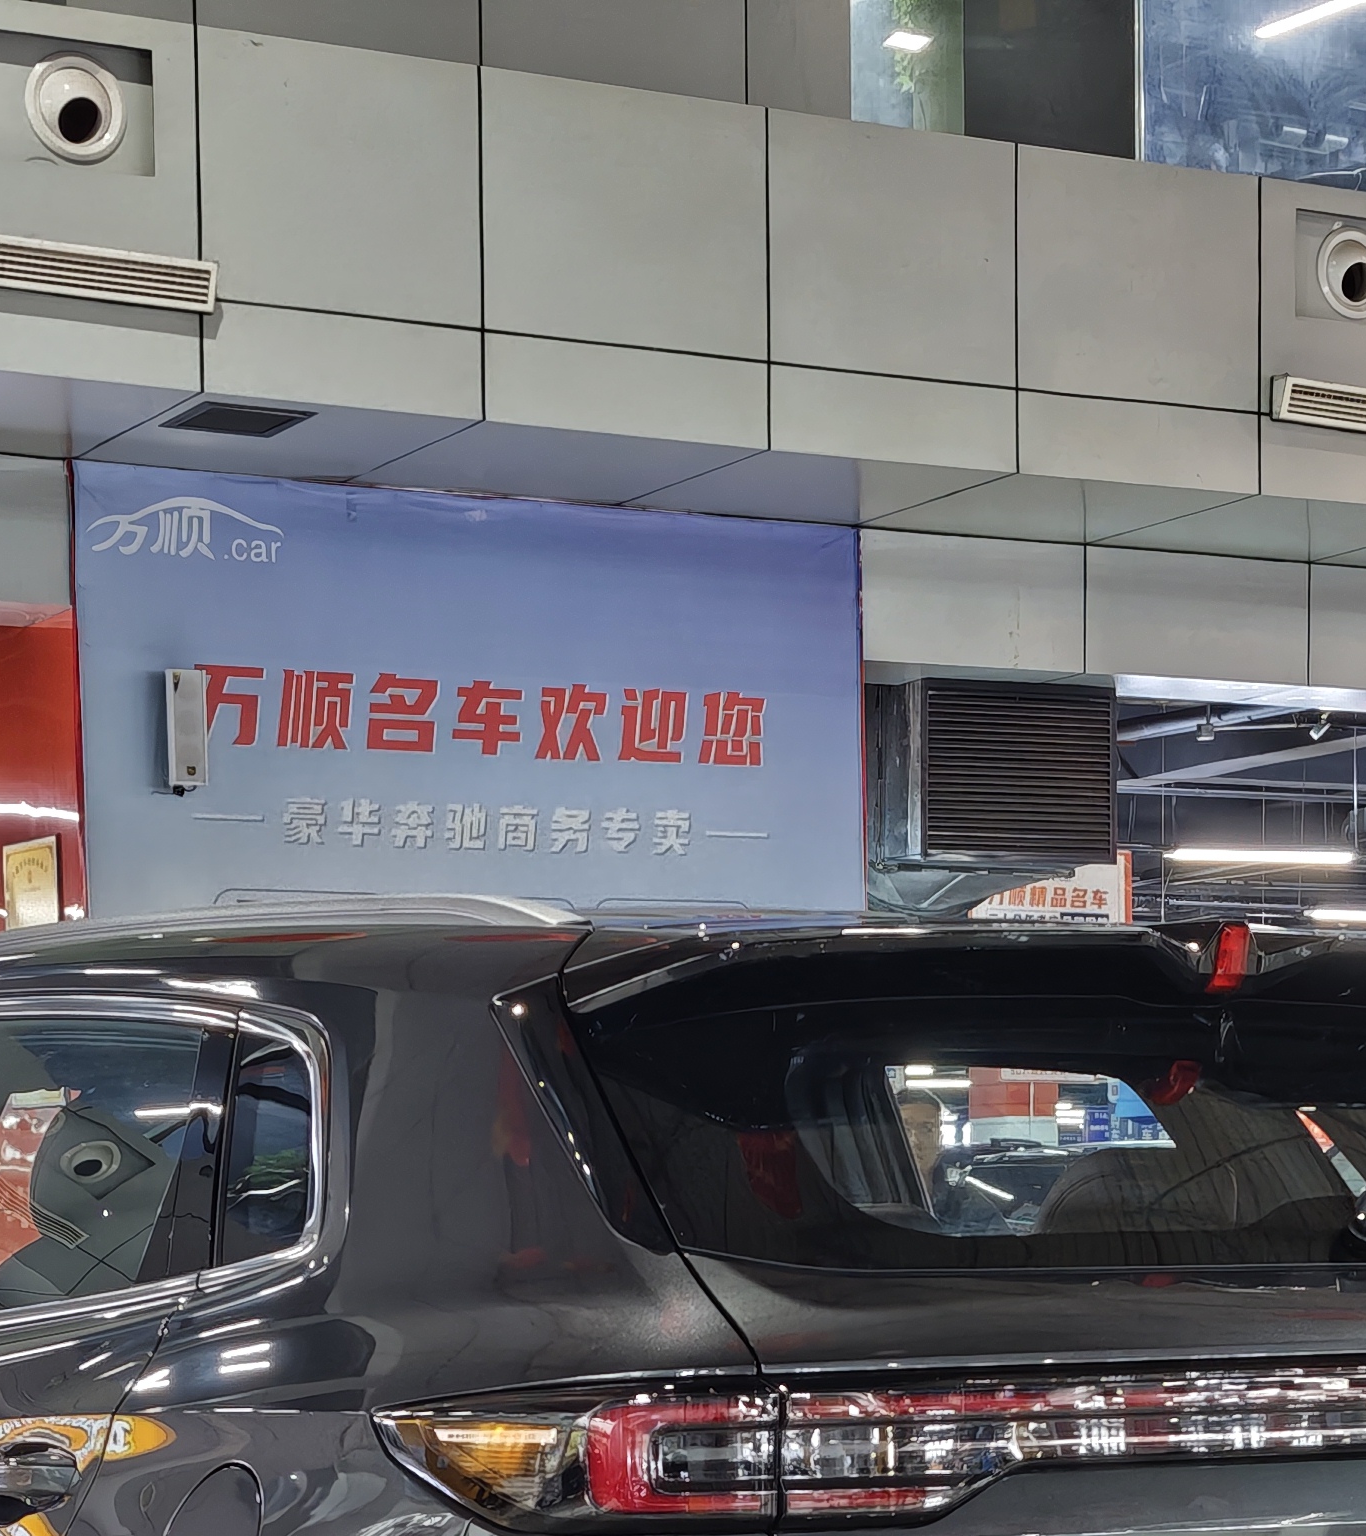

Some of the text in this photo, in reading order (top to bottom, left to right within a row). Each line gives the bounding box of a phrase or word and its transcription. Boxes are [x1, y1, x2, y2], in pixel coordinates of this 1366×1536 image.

[195, 663, 769, 767] 万顺名车欢迎您
[283, 796, 693, 857] 豪华奔驰商务专卖
